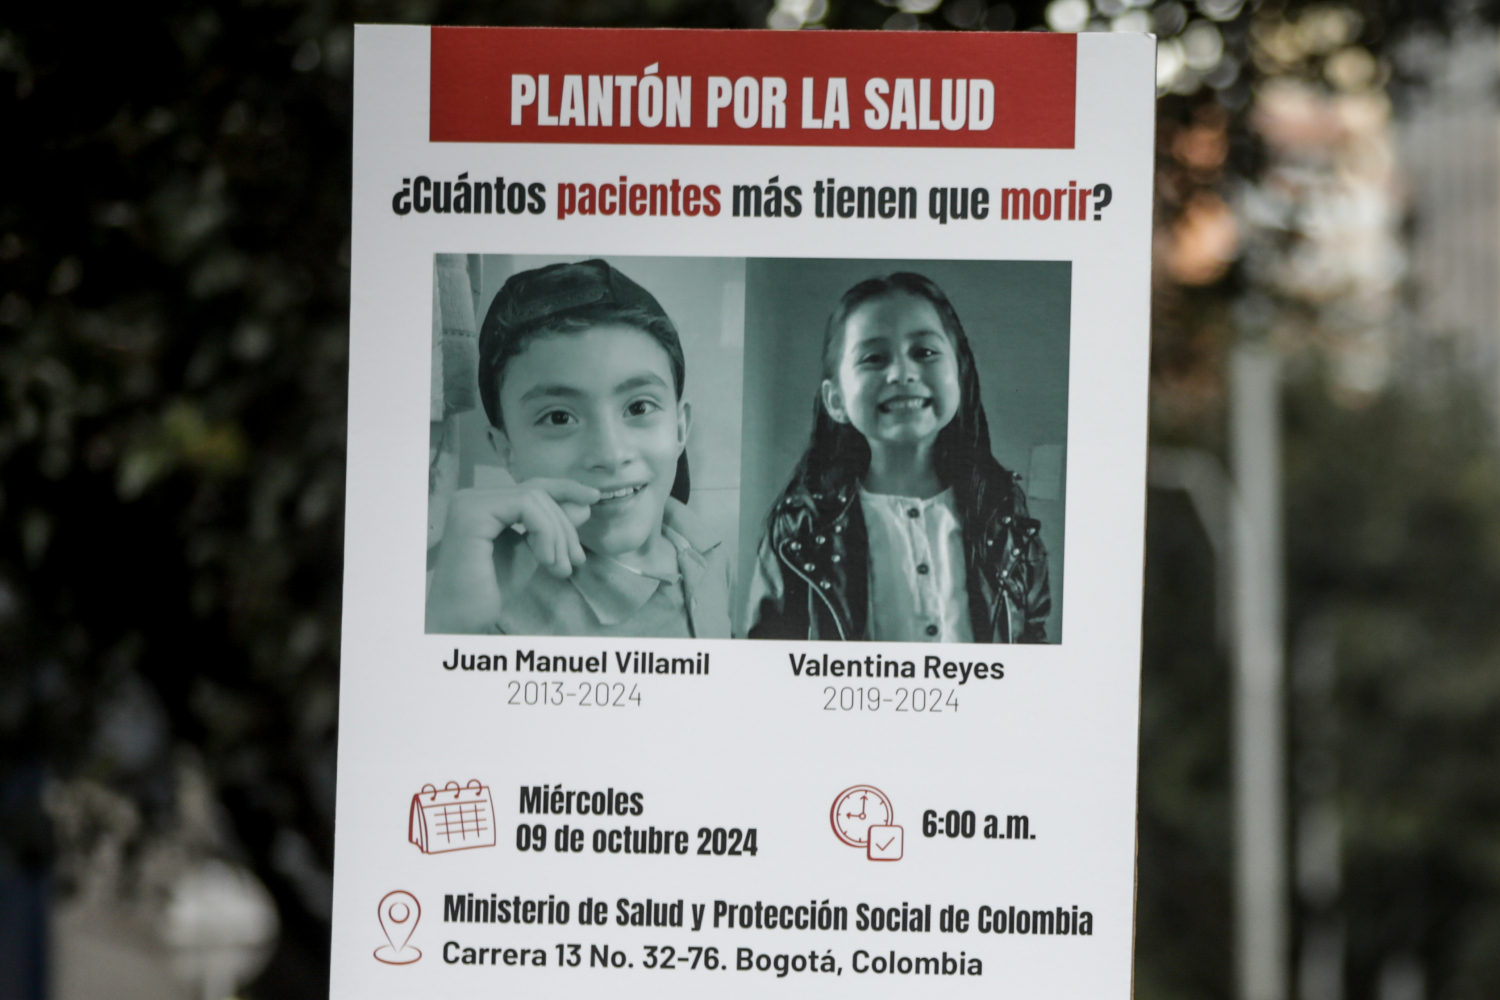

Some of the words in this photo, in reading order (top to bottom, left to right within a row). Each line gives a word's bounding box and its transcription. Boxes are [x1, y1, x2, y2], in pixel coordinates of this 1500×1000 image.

[511, 62, 691, 127] PLANTÓN
[707, 76, 787, 128] POR
[802, 77, 850, 129] LA
[864, 78, 994, 130] SALUD
[392, 172, 546, 216] ¿Cuántos
[557, 176, 721, 220] pacientes
[733, 175, 802, 218] más
[813, 178, 917, 219] tienen
[929, 187, 989, 224] que
[1001, 181, 1112, 221] morir?
[443, 649, 507, 671] Juan
[516, 650, 607, 673] Manuel
[615, 651, 709, 674] Villamil
[789, 654, 915, 678] Valentina
[924, 656, 1004, 685] Reyes
[508, 680, 641, 706] 2013-2024
[824, 686, 958, 712] 2019-2024
[520, 784, 643, 816] Miércoles
[516, 824, 546, 852] 09
[555, 825, 584, 852] de
[593, 826, 688, 855] octubre
[697, 827, 758, 856] 2024
[923, 810, 976, 838] 6:00
[984, 815, 1036, 839] a.m.
[444, 893, 570, 924] Ministerio
[579, 898, 608, 925] de
[616, 898, 683, 927] Salud
[691, 904, 705, 931] y
[714, 899, 847, 930] Protección
[856, 902, 931, 932] Social
[940, 905, 969, 933] de
[978, 905, 1093, 935] Colombia
[443, 941, 546, 966] Carrera
[556, 944, 581, 967] 13
[590, 945, 633, 968] No.
[643, 946, 726, 970] 32-76.
[737, 948, 842, 978] Bogotá,
[852, 950, 982, 975] Colombia
